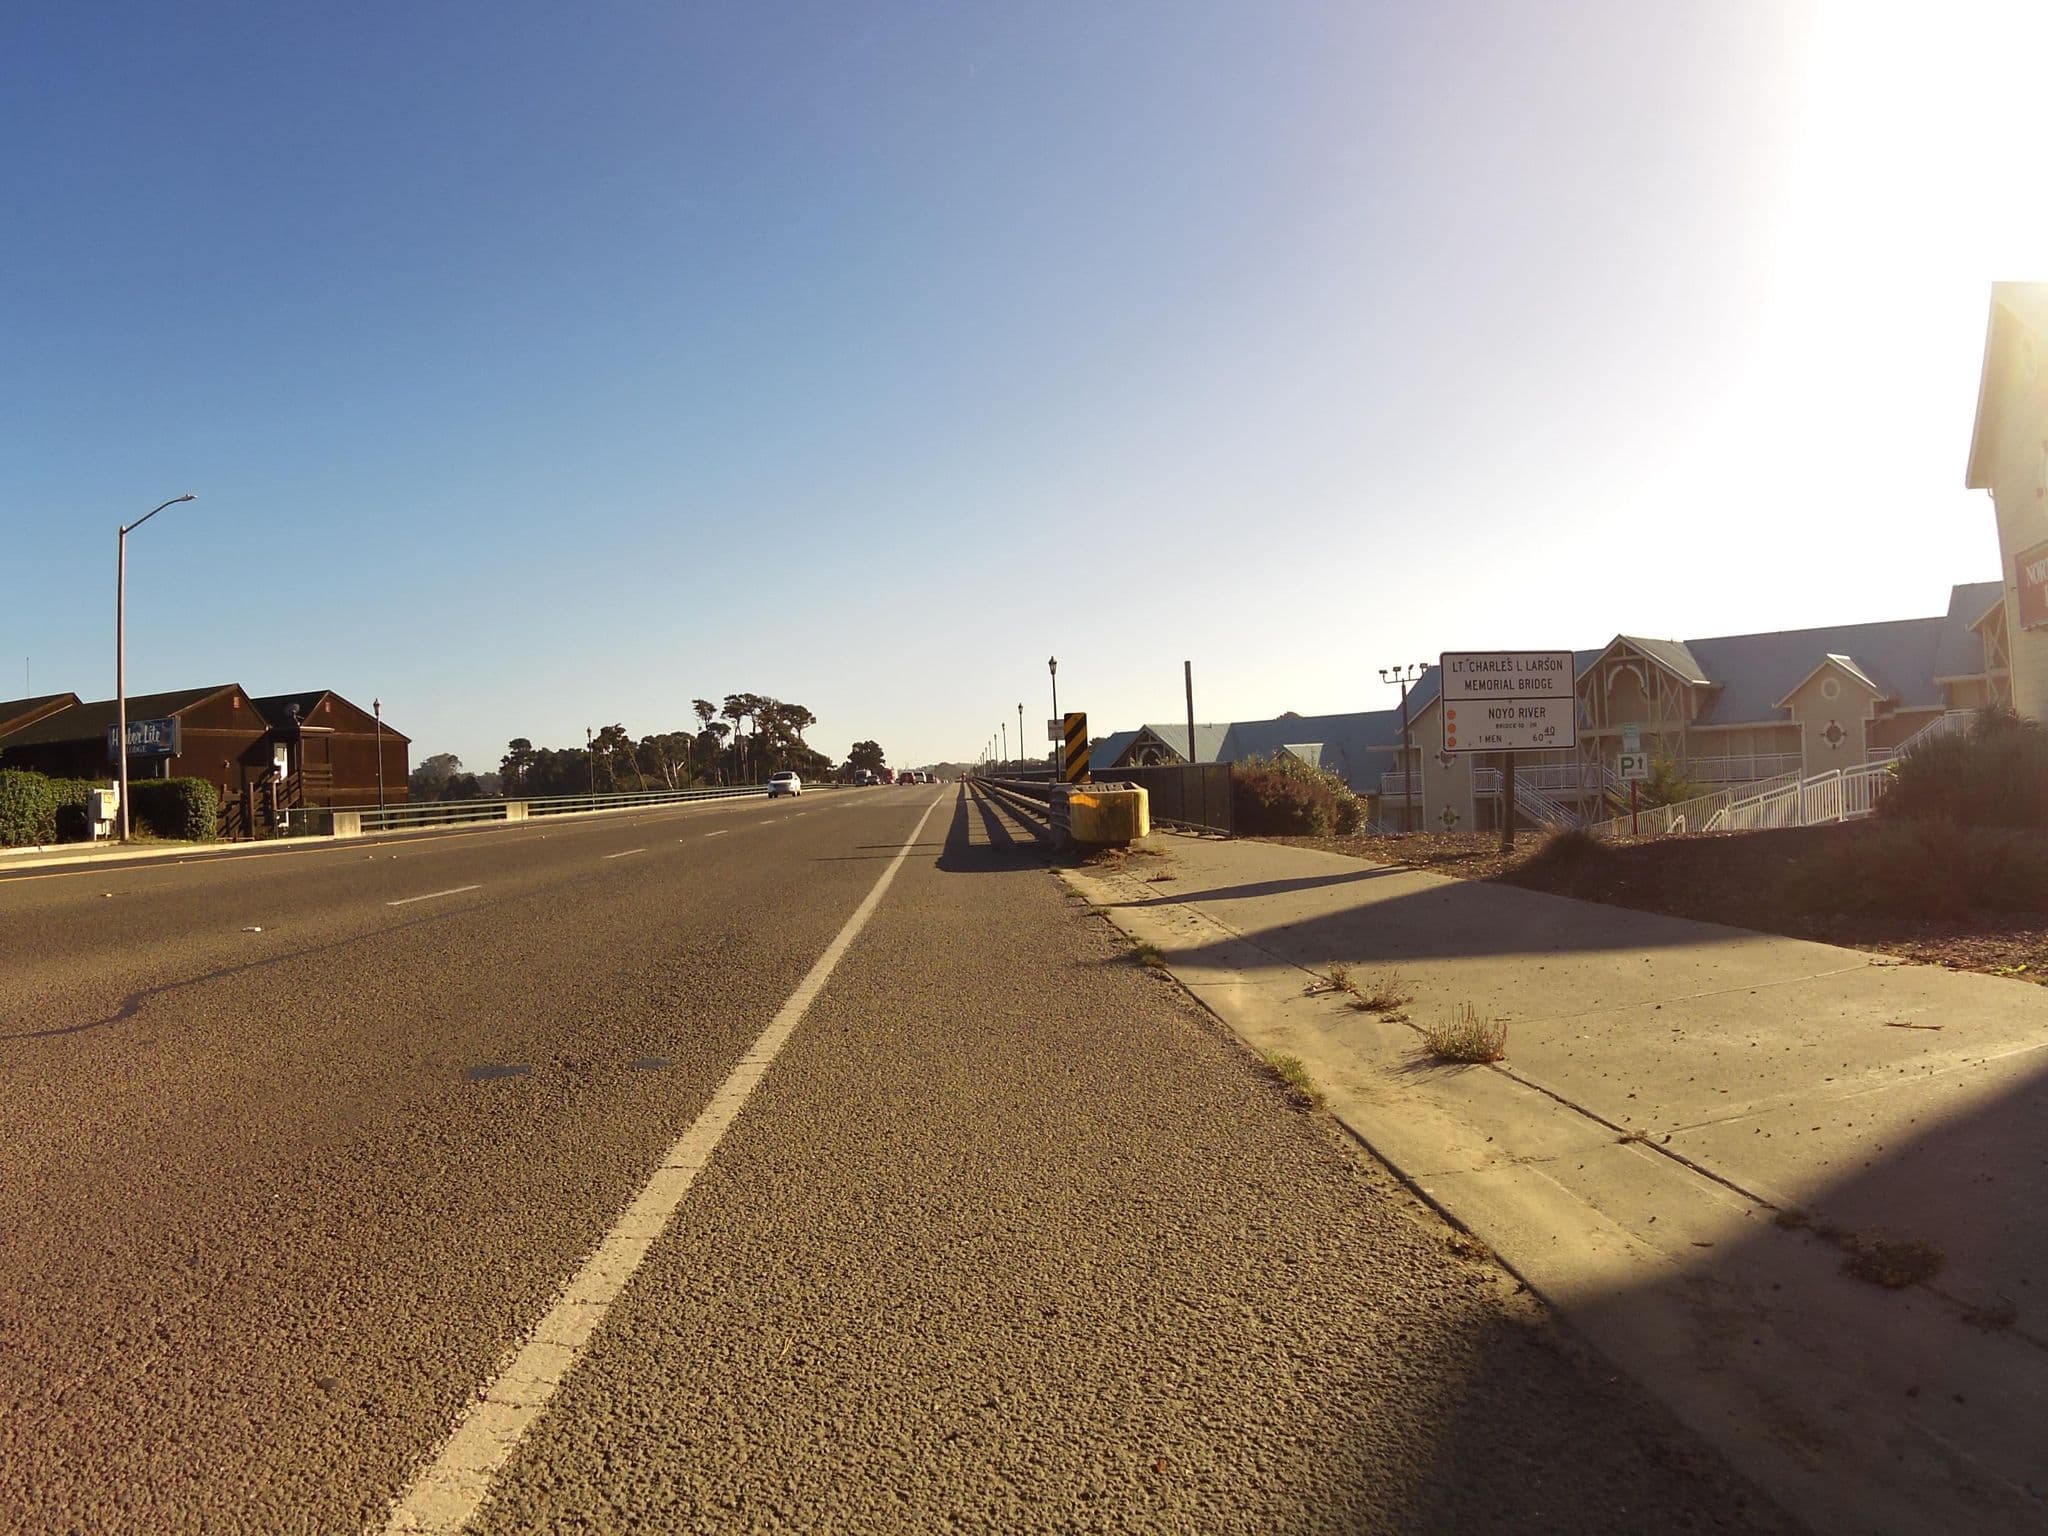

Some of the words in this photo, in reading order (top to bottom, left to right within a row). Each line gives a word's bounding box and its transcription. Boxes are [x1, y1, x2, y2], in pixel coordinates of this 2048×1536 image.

[1469, 660, 1513, 672] CHARLES
[1526, 660, 1563, 671] LARSON
[1465, 679, 1515, 690] MEMORIAL
[1519, 678, 1553, 689] BRIDGE
[1488, 707, 1515, 719] NOYO
[1519, 707, 1546, 718] RIVER
[1621, 757, 1634, 777] P
